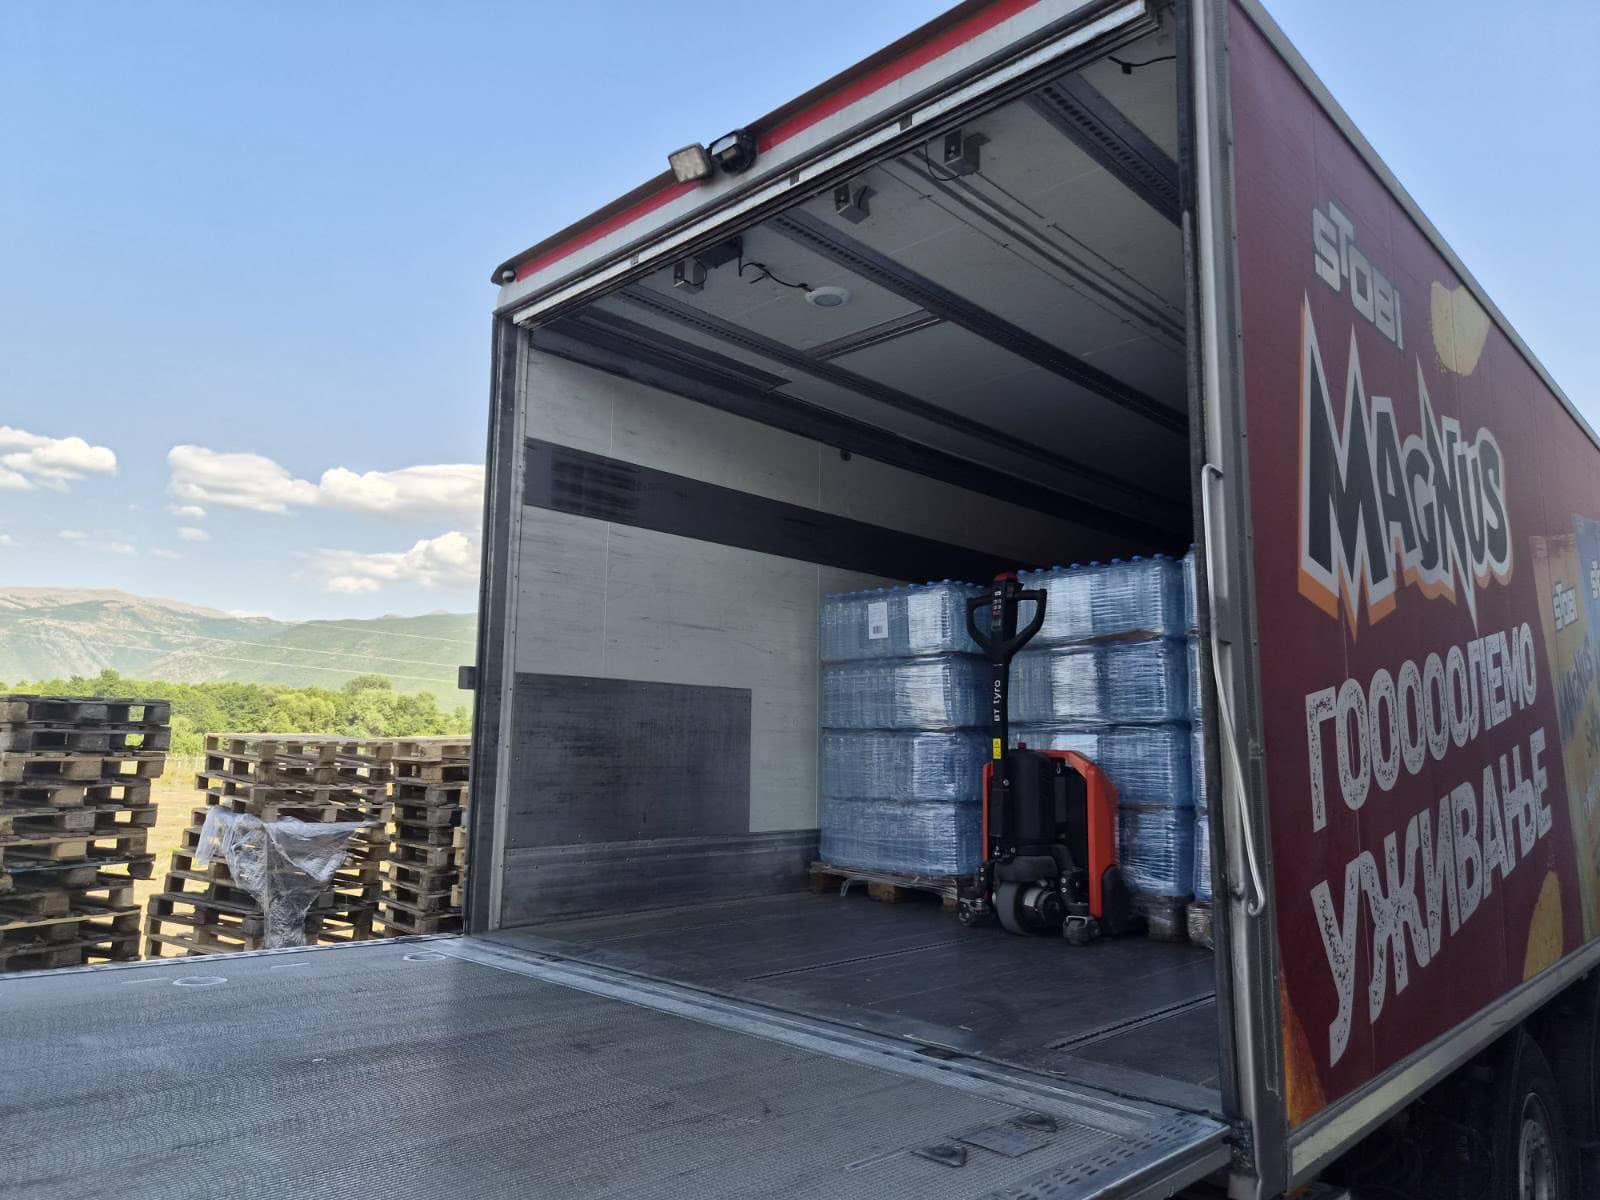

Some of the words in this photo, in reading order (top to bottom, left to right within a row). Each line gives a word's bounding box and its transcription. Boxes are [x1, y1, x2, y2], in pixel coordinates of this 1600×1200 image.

[1313, 201, 1404, 349] STOBI
[1299, 288, 1513, 640] MAGNUS
[993, 679, 1002, 705] tyro
[994, 708, 1001, 722] BT
[1306, 622, 1537, 833] ГОООООЛЕМО
[1310, 727, 1553, 1068] УЖИВАЊЕ
